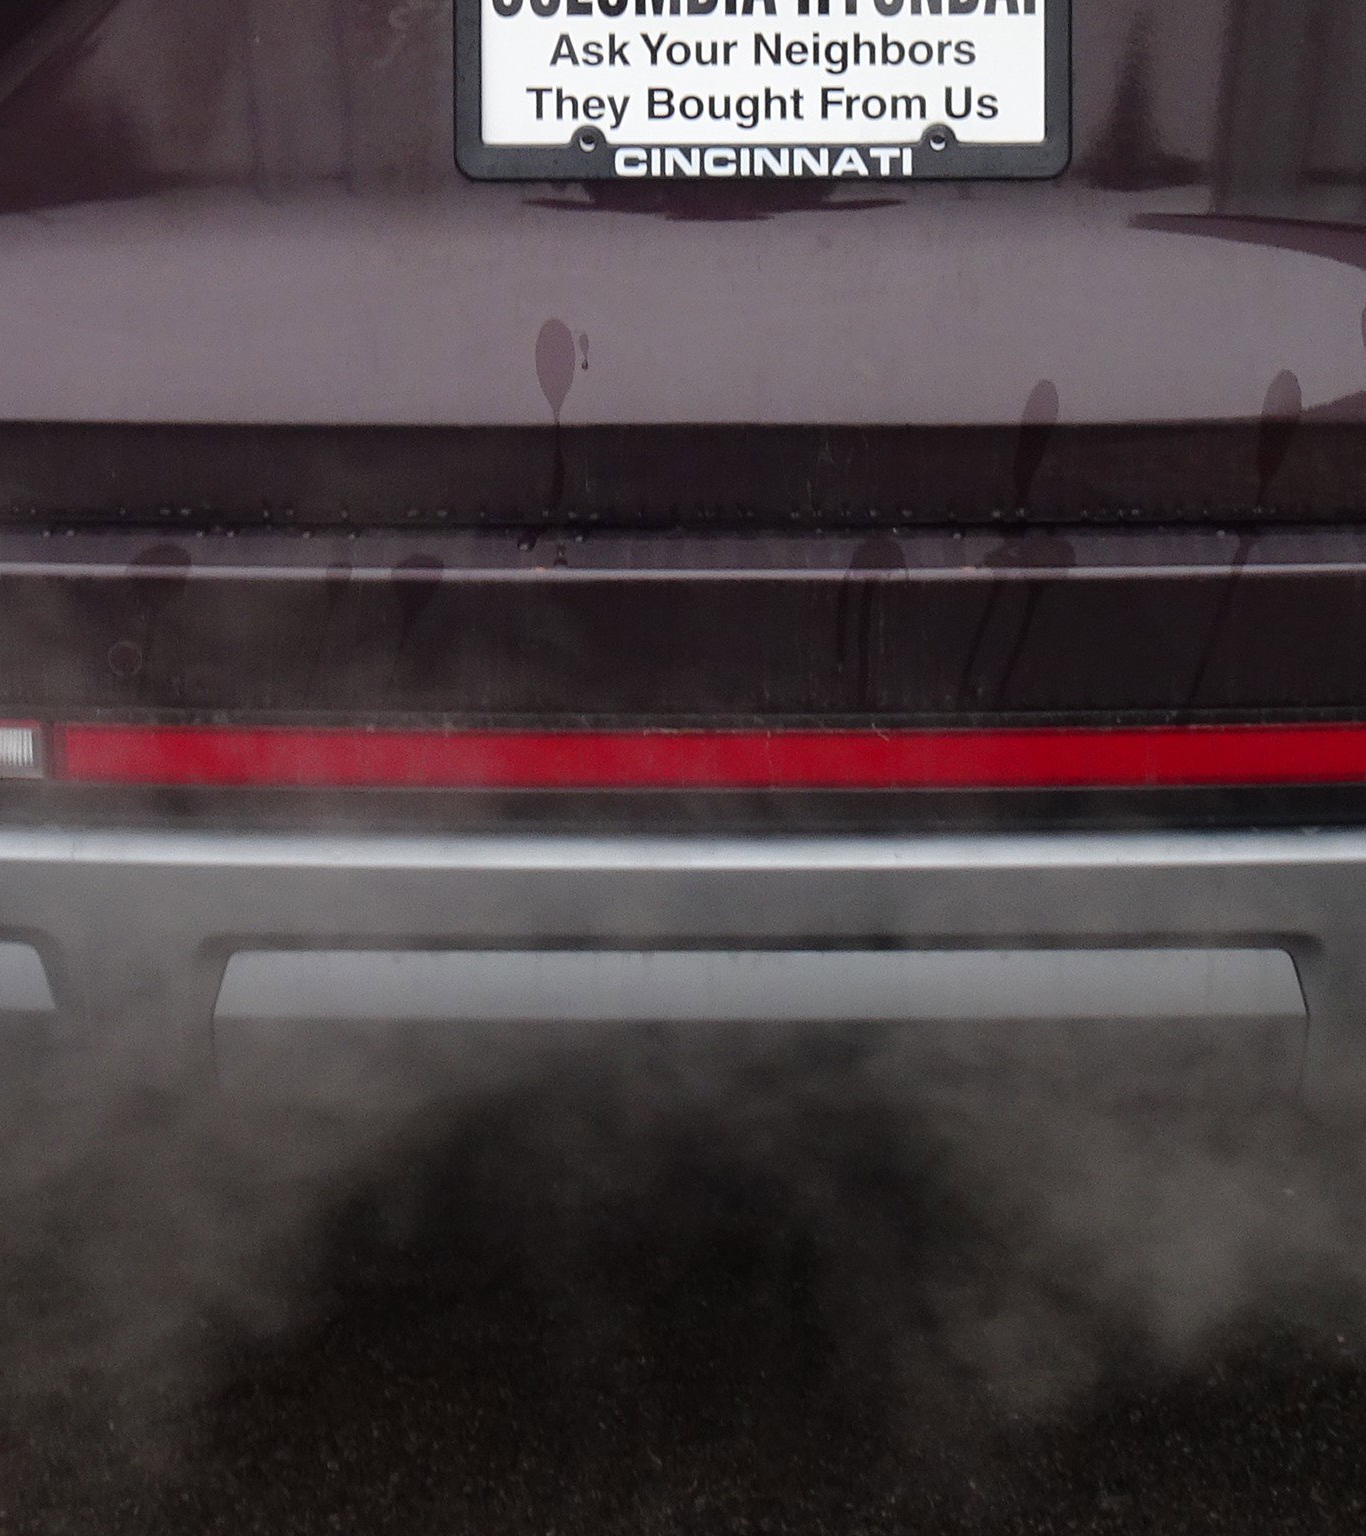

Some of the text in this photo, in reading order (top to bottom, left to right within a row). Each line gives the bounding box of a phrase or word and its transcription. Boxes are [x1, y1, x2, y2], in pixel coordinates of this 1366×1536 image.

[549, 31, 976, 75] Ask Your Neighbors
[526, 85, 999, 130] They Bought From Us
[614, 147, 914, 177] CINCINNATI
